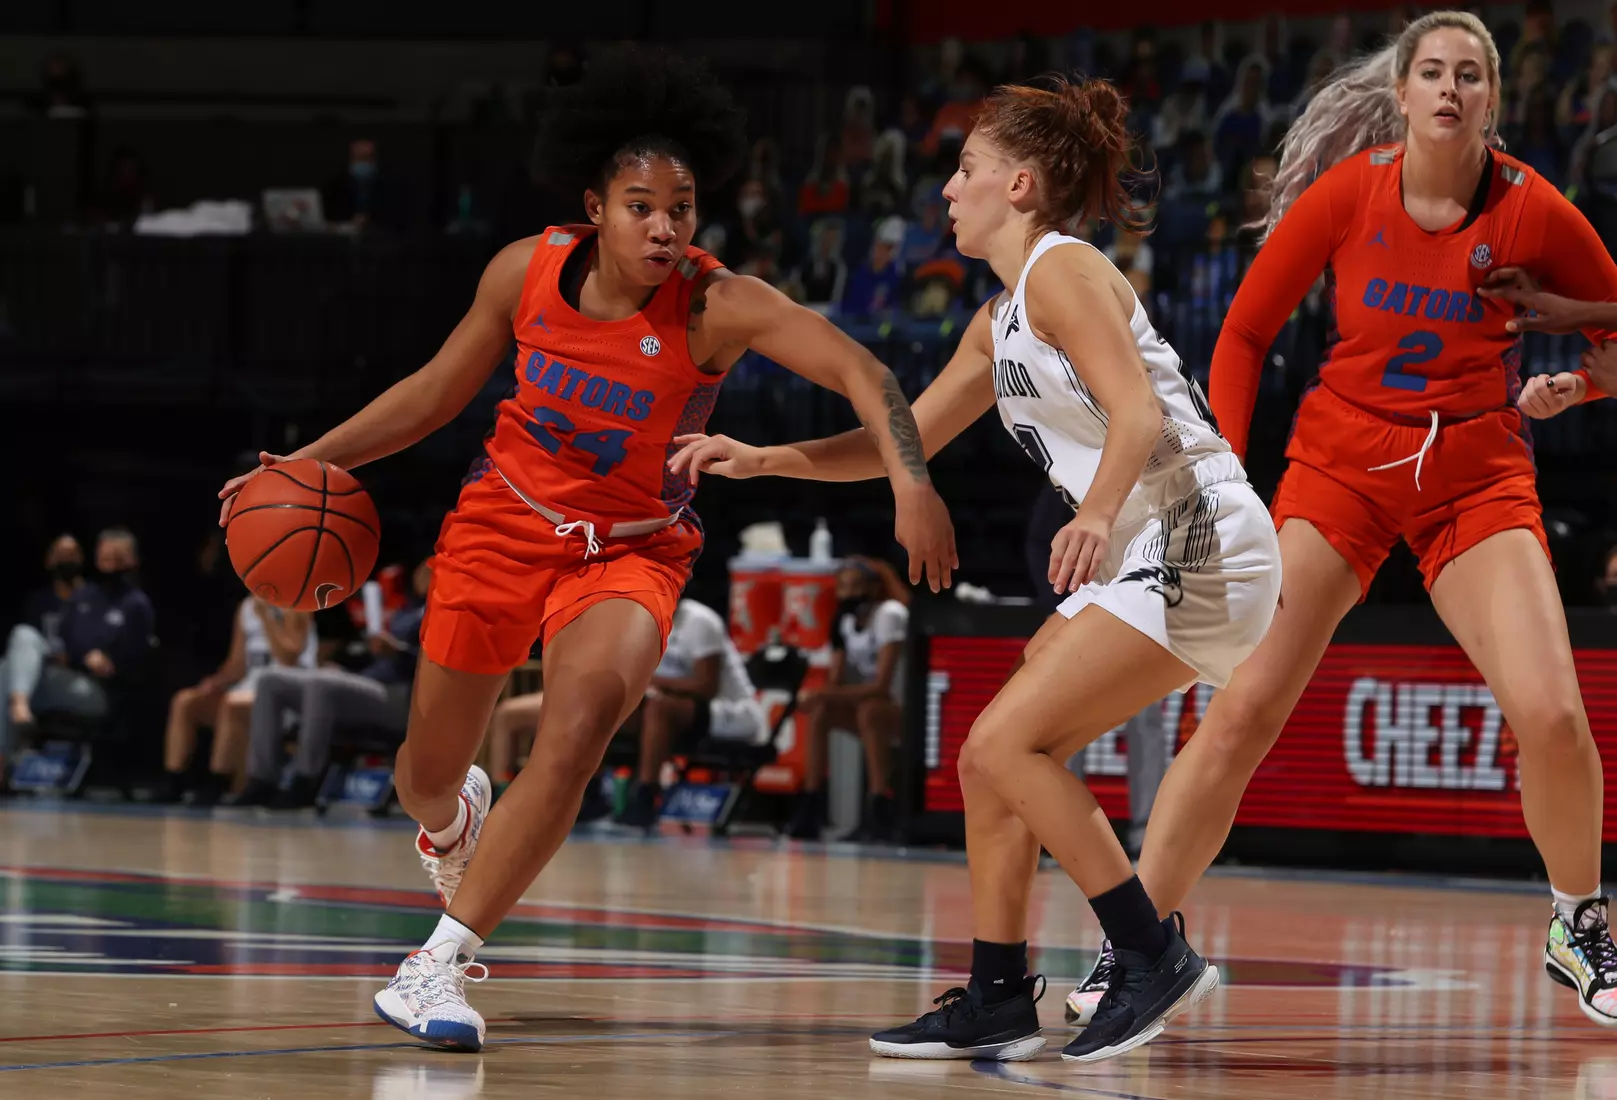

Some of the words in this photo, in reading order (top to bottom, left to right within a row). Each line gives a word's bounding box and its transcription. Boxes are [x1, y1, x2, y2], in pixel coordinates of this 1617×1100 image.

[1363, 278, 1485, 323] GATORS
[641, 337, 659, 355] SEC
[1381, 331, 1443, 392] 2
[525, 351, 655, 422] GATORS
[524, 406, 635, 478] 24
[1343, 678, 1520, 791] CHEEZ
